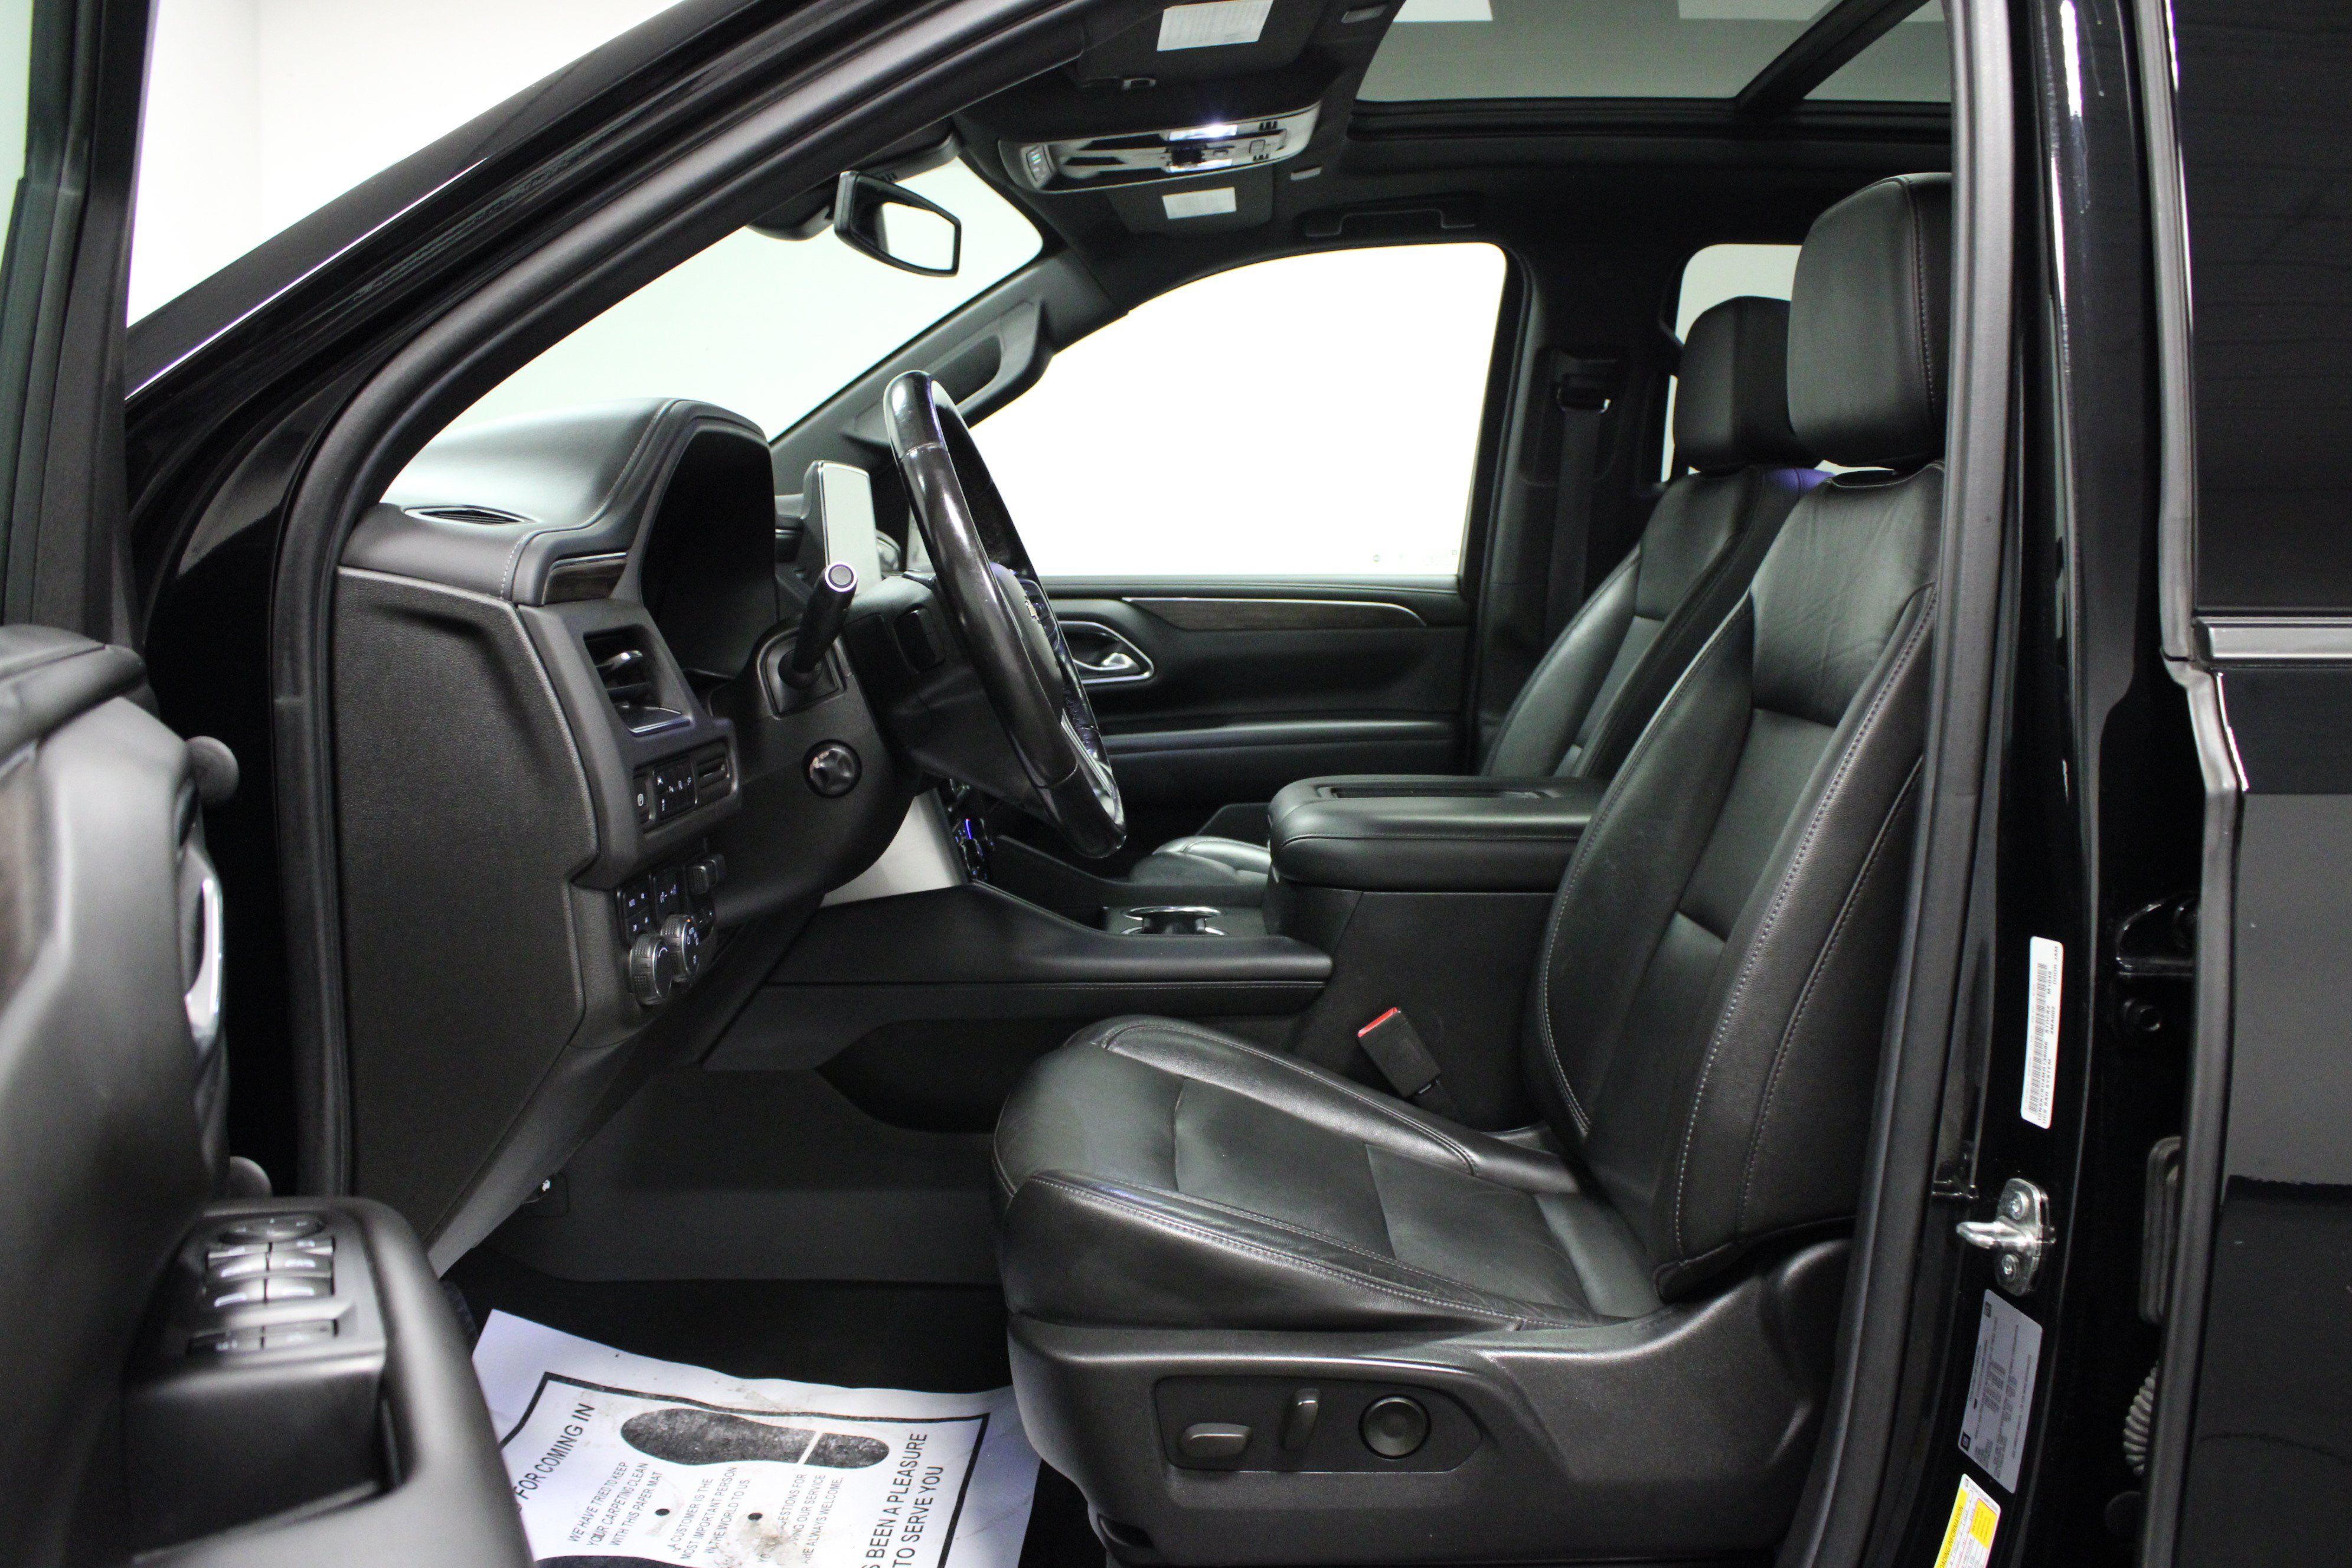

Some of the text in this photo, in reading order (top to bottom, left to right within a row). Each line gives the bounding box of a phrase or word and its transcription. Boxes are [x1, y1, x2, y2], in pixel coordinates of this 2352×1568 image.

[514, 1403, 596, 1500] FOR COMING IN
[887, 1433, 927, 1503] PLEASURE
[567, 1462, 628, 1543] WE HAVE TRIED TO KEEP
[586, 1462, 648, 1546] YOUR CARPETING CLEAN
[694, 1494, 704, 1504] IS
[698, 1478, 713, 1494] THE
[792, 1474, 807, 1487] FOR
[796, 1475, 826, 1522] OUR SERVICE
[609, 1471, 663, 1546] WITH THIS PAPER MAT
[671, 1498, 700, 1542] CUSTOMER
[680, 1466, 738, 1560] MOST IMPORTANT PERSON
[708, 1531, 726, 1544] THE
[717, 1502, 739, 1530] WORLD
[731, 1491, 744, 1500] TO
[800, 1477, 844, 1564] ARE ALWAYS WELCOME.
[883, 1507, 901, 1515] A
[892, 1466, 944, 1568] TO SERVE YOU
[1948, 1505, 1964, 1546] INFORMATION
[865, 1519, 896, 1559] BEEN
